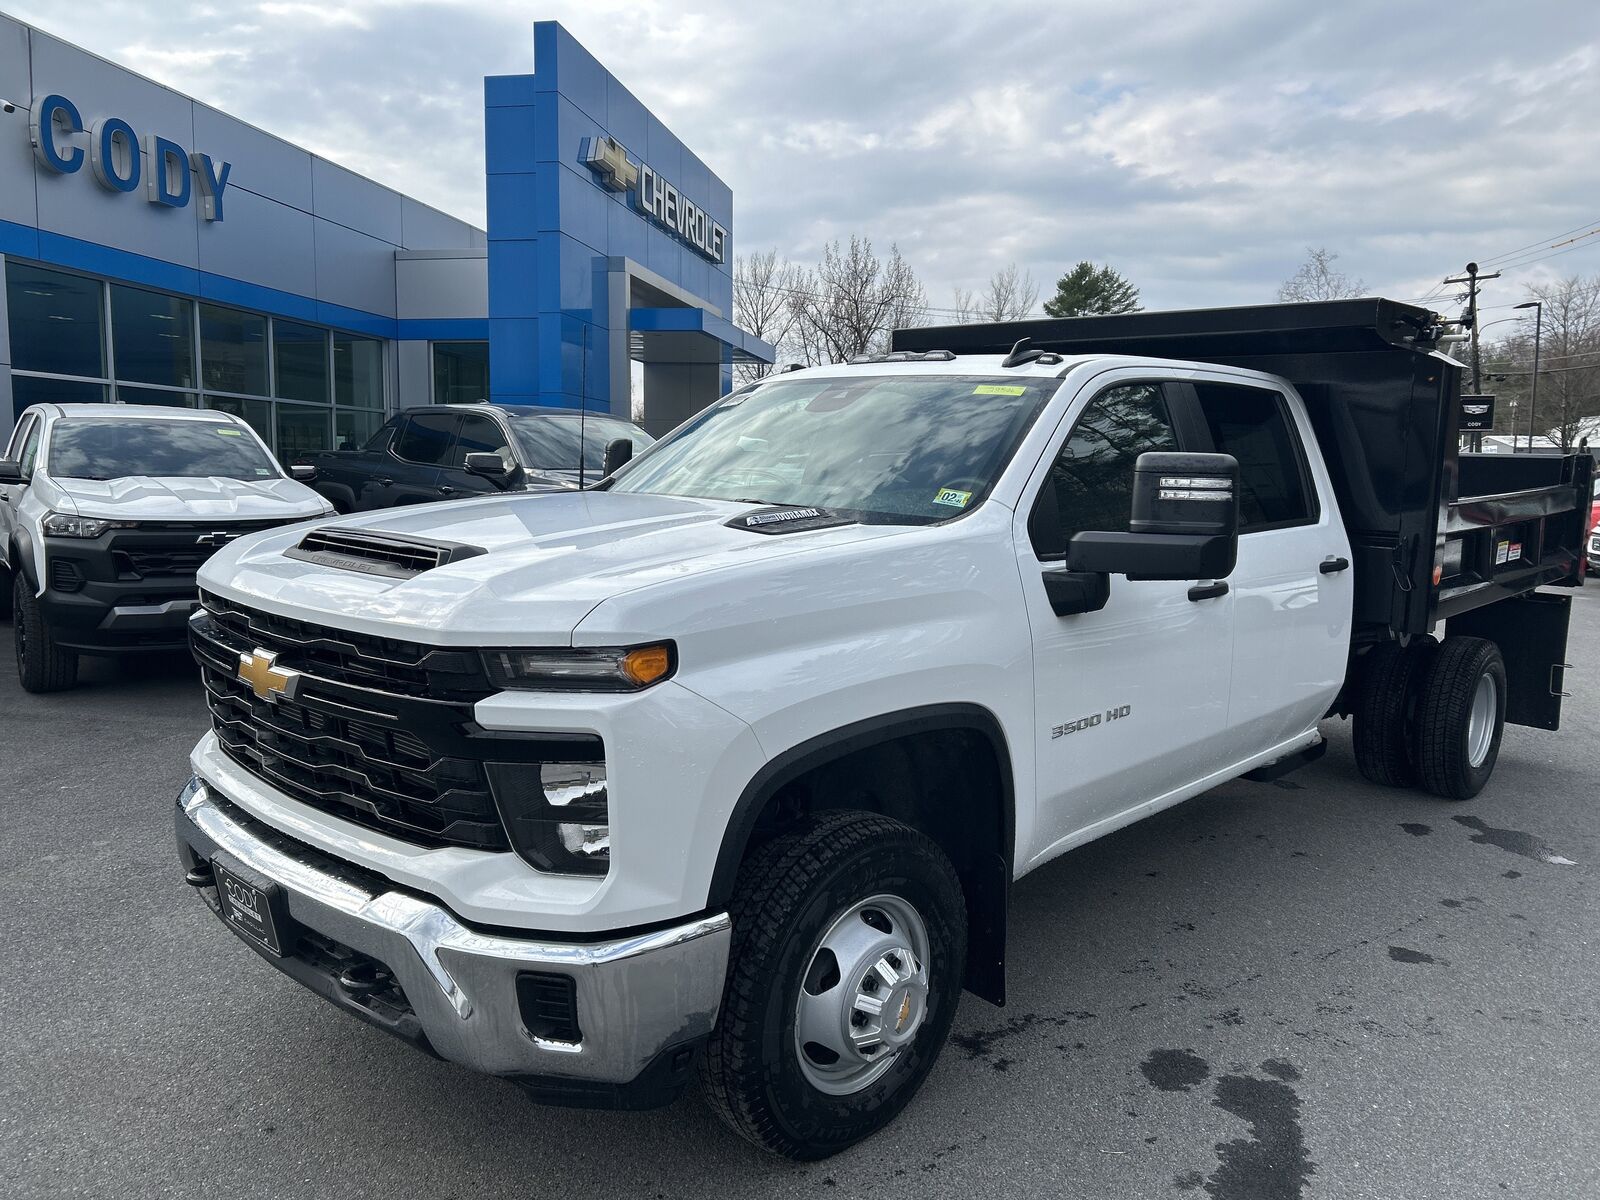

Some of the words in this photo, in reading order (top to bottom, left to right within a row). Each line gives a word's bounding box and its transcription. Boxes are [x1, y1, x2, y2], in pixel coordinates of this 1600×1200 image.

[30, 94, 231, 222] CODY
[639, 163, 727, 264] CHEVROLET
[941, 492, 957, 502] 02
[777, 508, 820, 521] DURAMAX
[311, 554, 376, 572] CHEVROLET
[1051, 713, 1102, 740] 3500
[1106, 705, 1131, 723] HD
[225, 878, 258, 912] CODY
